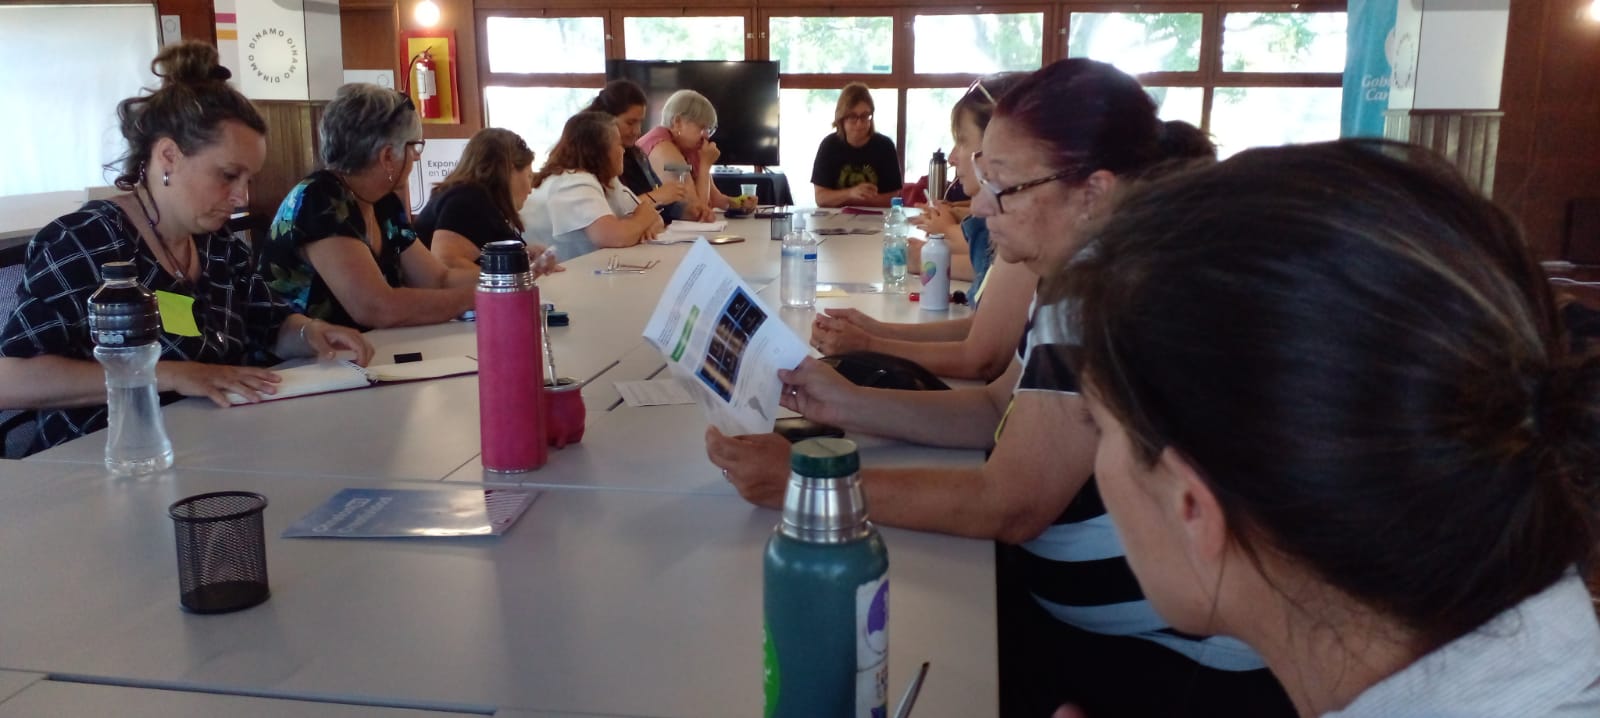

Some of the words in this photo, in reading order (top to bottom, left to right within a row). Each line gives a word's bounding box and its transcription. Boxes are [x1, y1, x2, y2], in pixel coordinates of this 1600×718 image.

[249, 28, 285, 49] DINAMO
[248, 54, 280, 83] DINAMO
[1361, 74, 1390, 88] Gob
